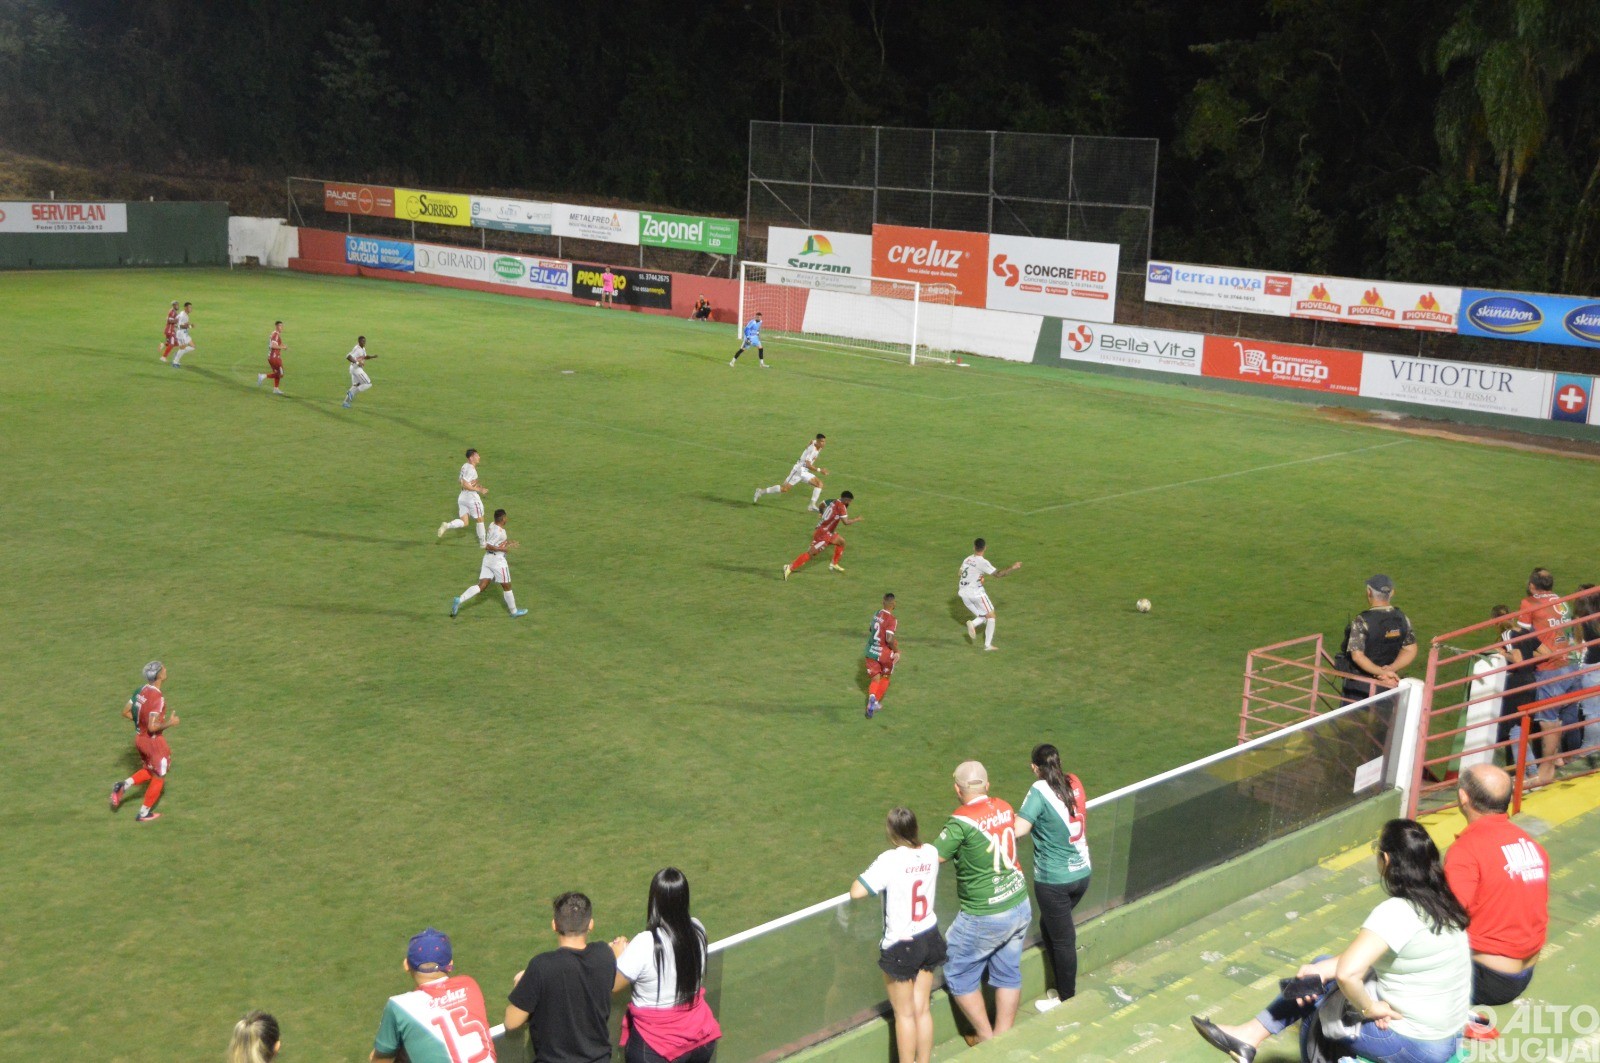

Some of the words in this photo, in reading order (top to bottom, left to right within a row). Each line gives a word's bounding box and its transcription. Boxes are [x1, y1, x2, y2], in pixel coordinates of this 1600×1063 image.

[326, 189, 357, 200] PALACE
[32, 204, 106, 220] SERVIPLAN
[569, 213, 611, 225] METALFRED
[642, 214, 704, 243] Zagonel
[350, 240, 357, 251] O
[358, 241, 379, 254] ALTO
[709, 238, 721, 247] LED
[347, 251, 379, 264] URUGUAI
[437, 251, 486, 271] GIRARDI
[888, 240, 963, 269] creluz
[540, 261, 567, 270] MERCADO
[1024, 264, 1107, 283] CONCREFRED
[530, 268, 567, 286] SILVA
[1023, 275, 1048, 284] Concreto
[1150, 273, 1168, 281] Coral
[1174, 269, 1215, 285] terra
[1219, 275, 1262, 290] nova
[1300, 300, 1340, 313] PIOVESAN
[1352, 306, 1392, 318] PIOVESAN
[1476, 305, 1533, 321] skinabon
[1407, 311, 1450, 323] PIOVESAN
[1100, 334, 1149, 353] Bella
[1153, 340, 1196, 359] Vita
[1272, 354, 1322, 365] Supermercado
[1262, 360, 1329, 380] LONGO
[1389, 359, 1514, 393] VITIOTUR
[1401, 384, 1442, 396] VIAGENS
[1453, 389, 1497, 403] TURISMO
[821, 504, 834, 521] 10
[961, 566, 970, 579] 6
[873, 621, 881, 642] 2
[979, 809, 1012, 832] creluz
[986, 827, 1017, 874] 10
[905, 864, 932, 874] creluz
[911, 879, 928, 922] 6
[427, 987, 467, 1010] creluz
[430, 1005, 497, 1063] 15
